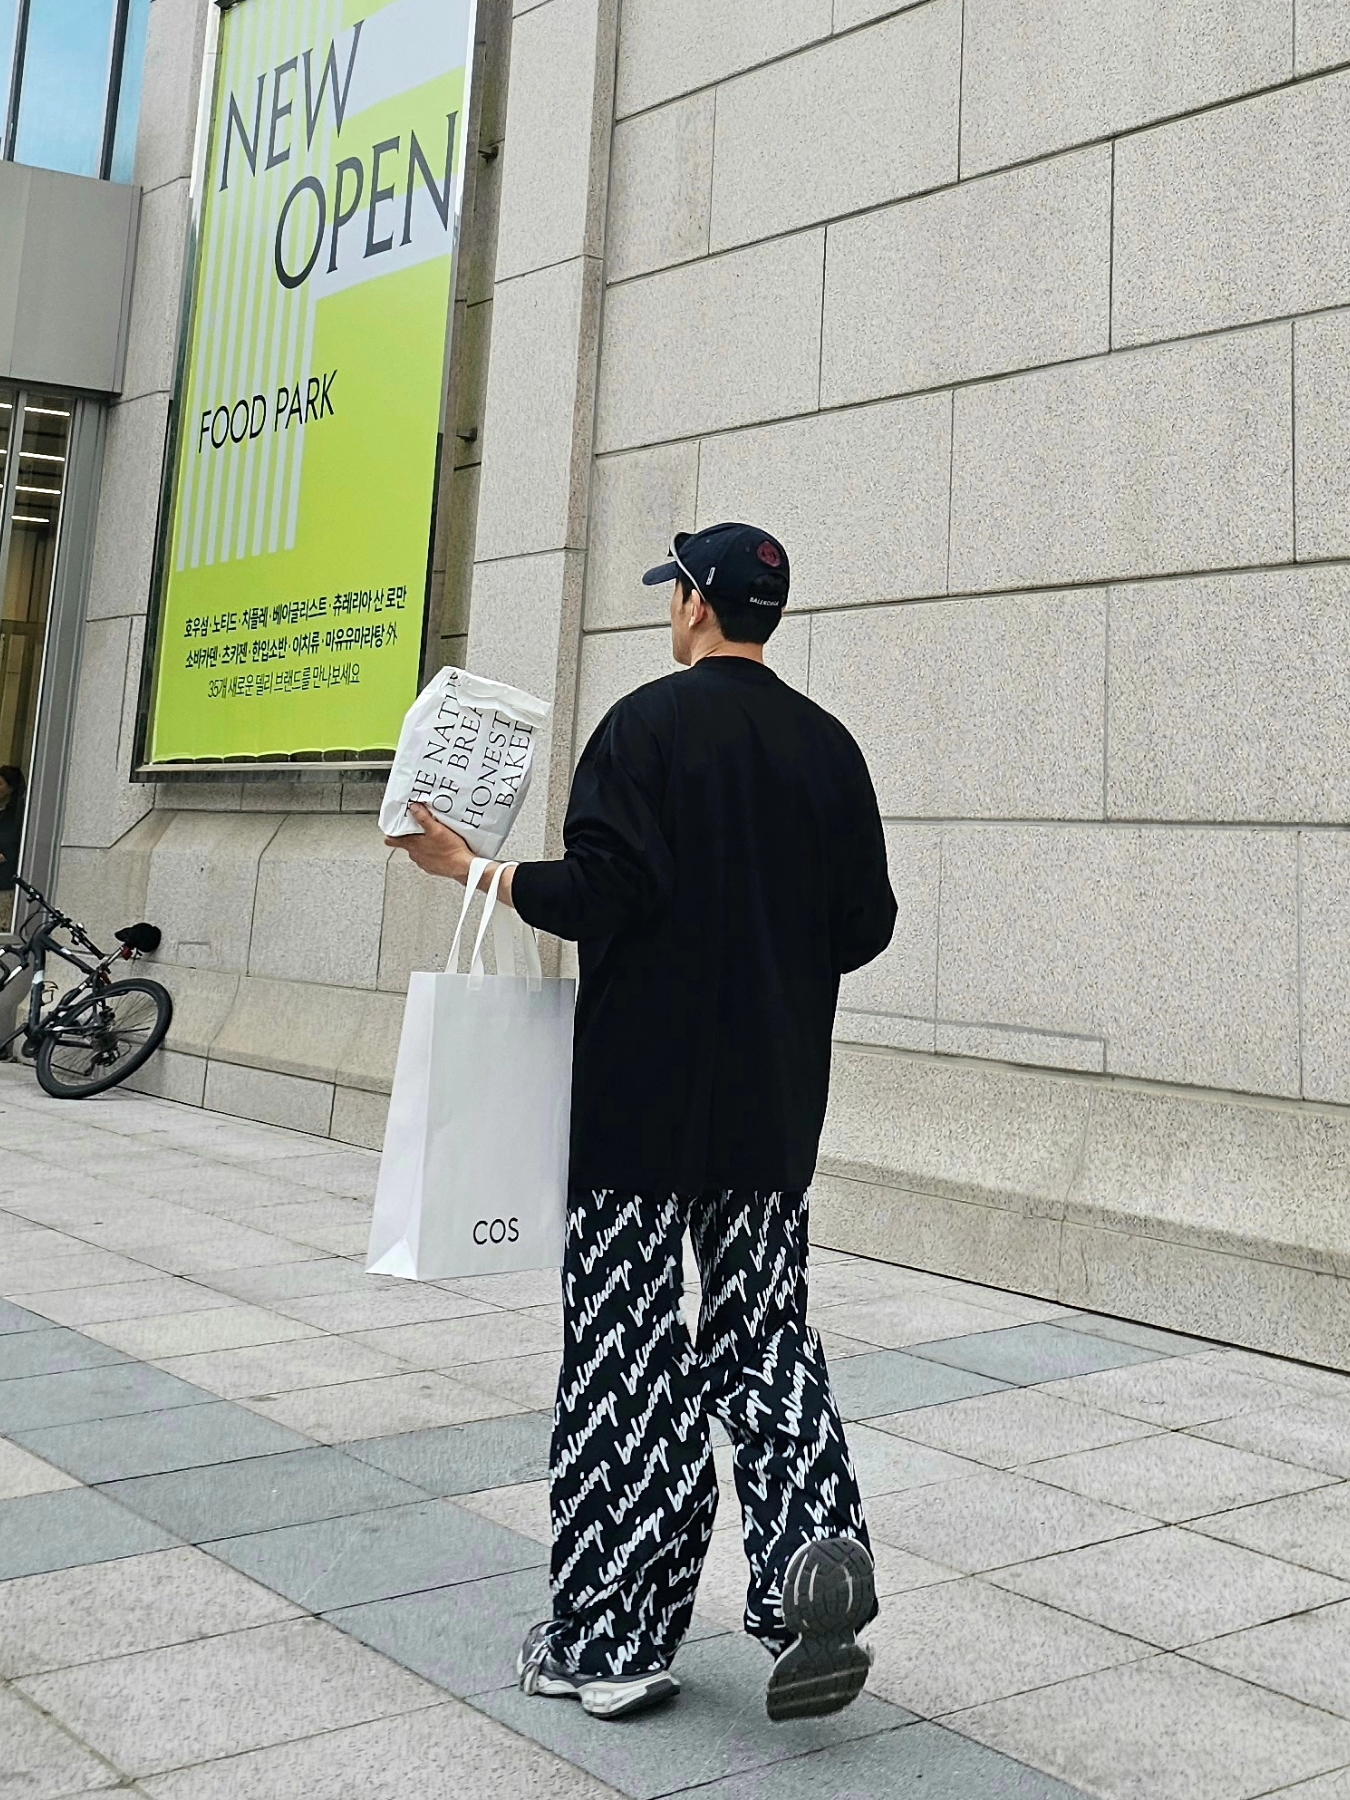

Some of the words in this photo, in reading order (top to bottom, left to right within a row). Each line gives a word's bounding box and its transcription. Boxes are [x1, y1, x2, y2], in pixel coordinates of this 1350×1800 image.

[218, 19, 365, 193] NEW
[274, 110, 459, 289] OPEN
[198, 394, 267, 454] FOOD
[273, 369, 338, 432] PARK
[184, 616, 209, 638] 호우섬
[212, 612, 237, 634] 노티드
[272, 596, 328, 626] 베이글리스트
[332, 589, 372, 617] 츄레리아
[373, 587, 385, 613] 산
[385, 584, 408, 609] 로만
[252, 636, 289, 663] 한입소반
[292, 631, 320, 657] 이치류
[325, 623, 385, 653] 마유유마라탕
[228, 674, 254, 698] 새로운
[255, 671, 274, 696] 델리
[273, 667, 311, 692] 브랜드를
[313, 662, 360, 689] 만나보세요
[432, 777, 460, 814] OF
[460, 710, 513, 829] HONEST
[473, 1217, 519, 1245] COS
